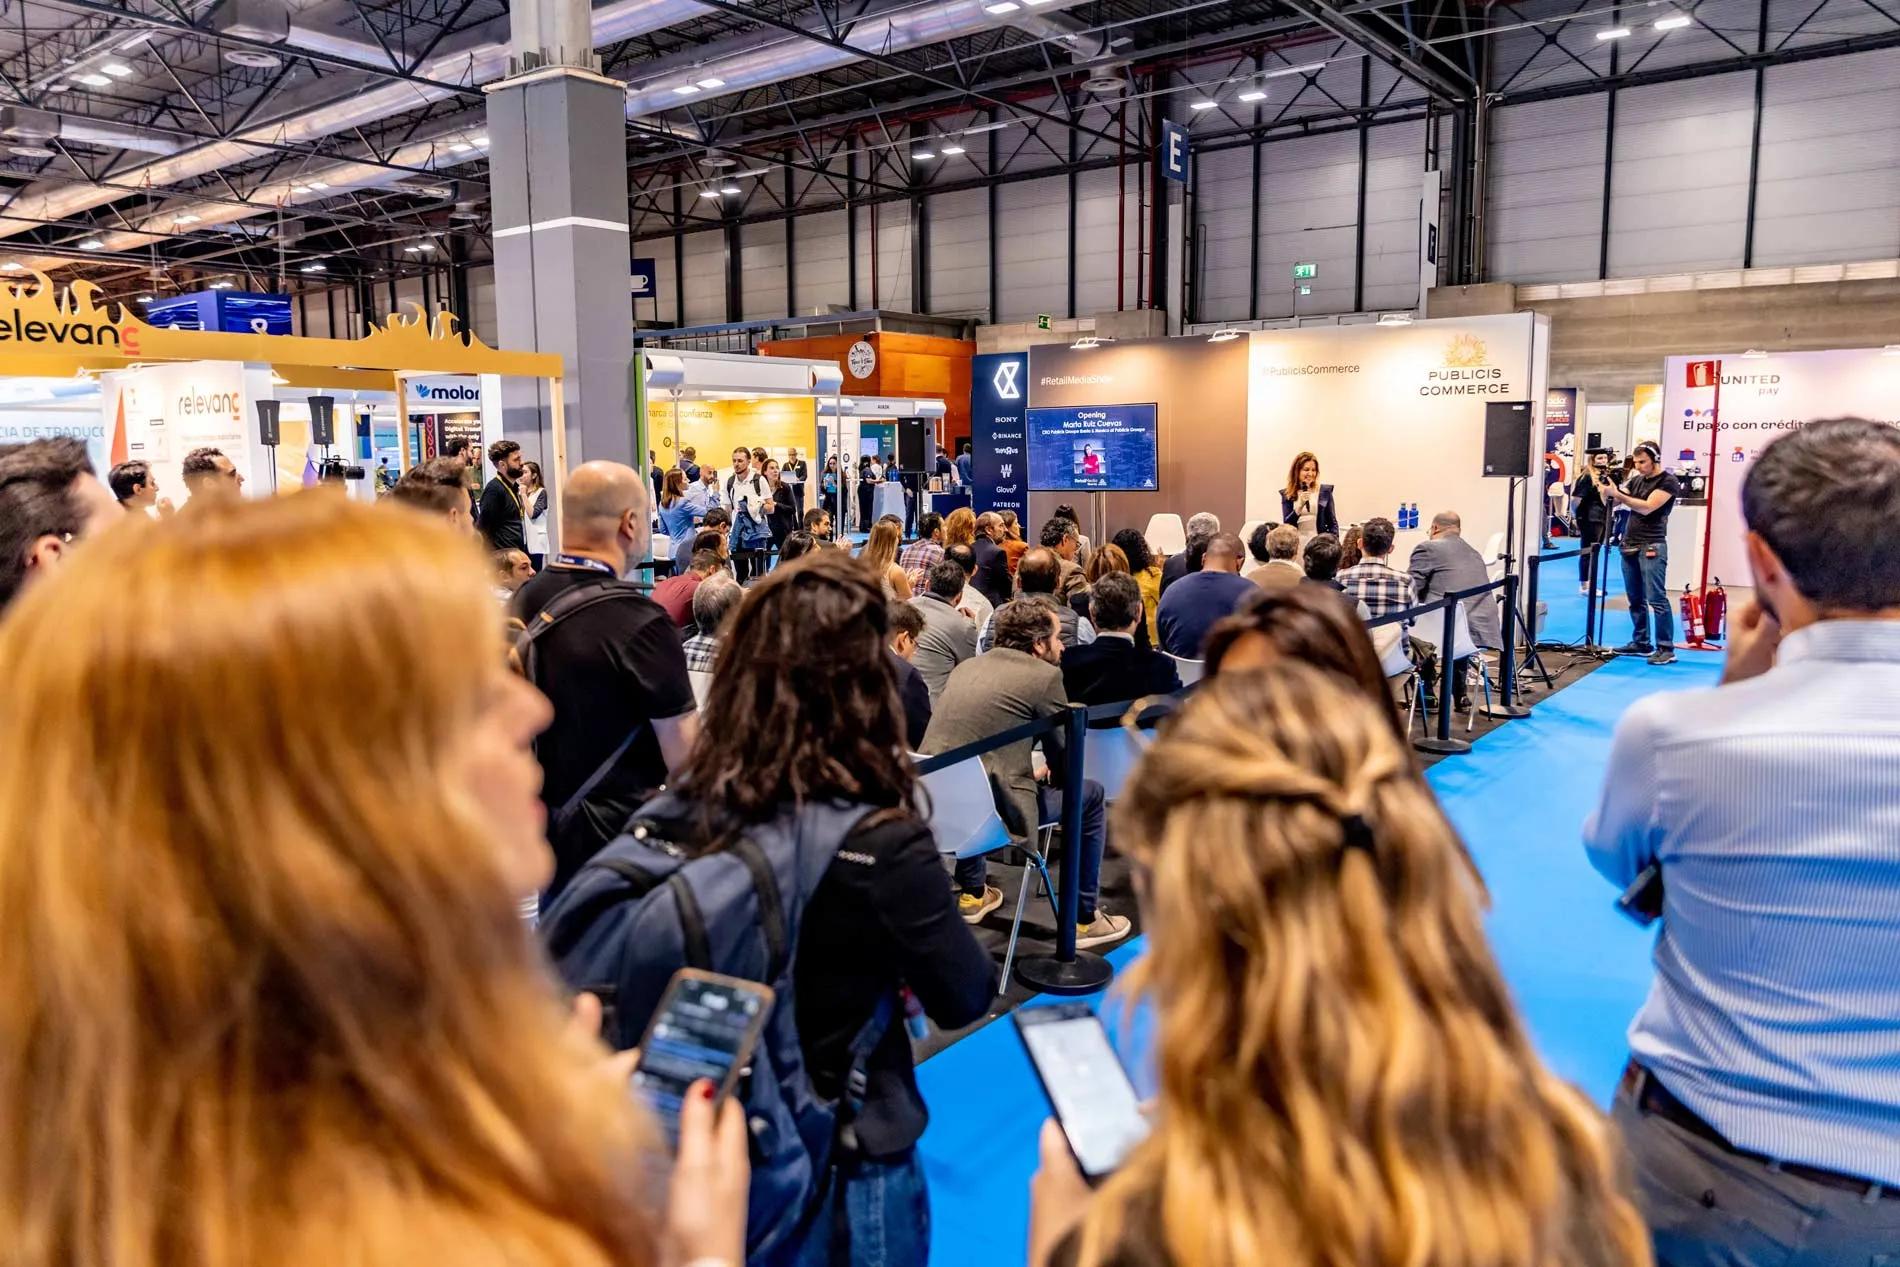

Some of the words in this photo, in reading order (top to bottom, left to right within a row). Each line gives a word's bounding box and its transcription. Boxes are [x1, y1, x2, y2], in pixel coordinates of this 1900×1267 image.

[1169, 131, 1182, 173] E
[1428, 368, 1502, 381] PUBLICIS
[1720, 374, 1781, 385] UNITED
[1419, 383, 1510, 396] COMMERCE
[1077, 411, 1107, 420] Opening
[1096, 420, 1122, 428] Cuevas
[1683, 420, 1694, 430] El
[1732, 422, 1758, 430] con
[23, 426, 40, 438] DE
[996, 486, 1014, 494] Glovo
